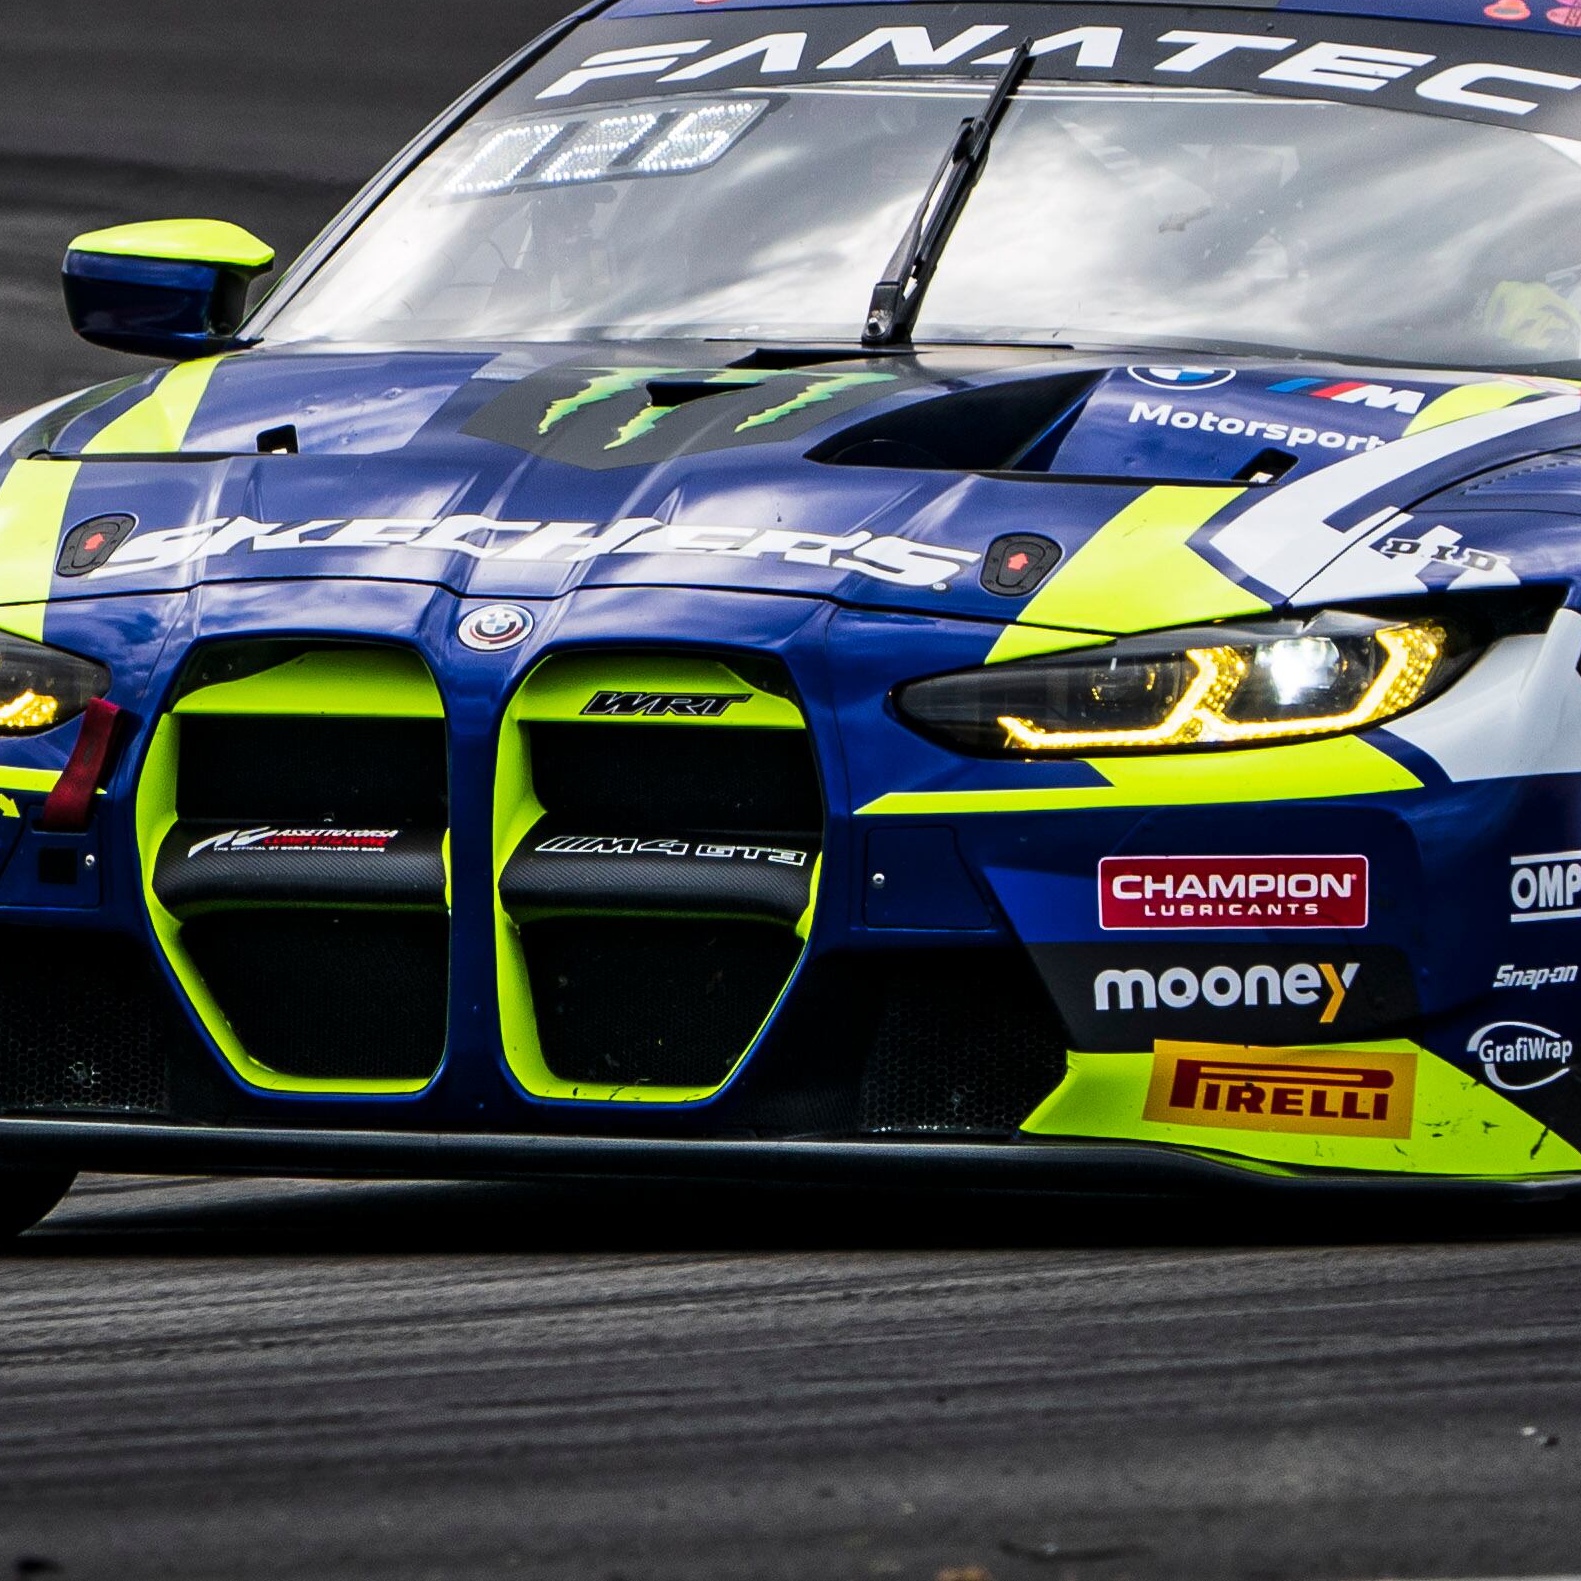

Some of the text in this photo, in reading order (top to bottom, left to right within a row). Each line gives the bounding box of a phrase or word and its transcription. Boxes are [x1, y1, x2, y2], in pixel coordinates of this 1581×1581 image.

[1128, 401, 1388, 452] Motorsport
[87, 514, 982, 587] SKECHERS
[579, 690, 754, 716] WRT
[695, 843, 808, 867] GT3
[1111, 873, 1355, 900] CHAMPION
[1144, 903, 1319, 916] LUBRICANTS
[1492, 964, 1579, 991] Snap-on
[1094, 962, 1361, 1023] mooney
[1479, 1036, 1573, 1064] GrafiWrap
[1168, 1058, 1394, 1121] PIRELLI
